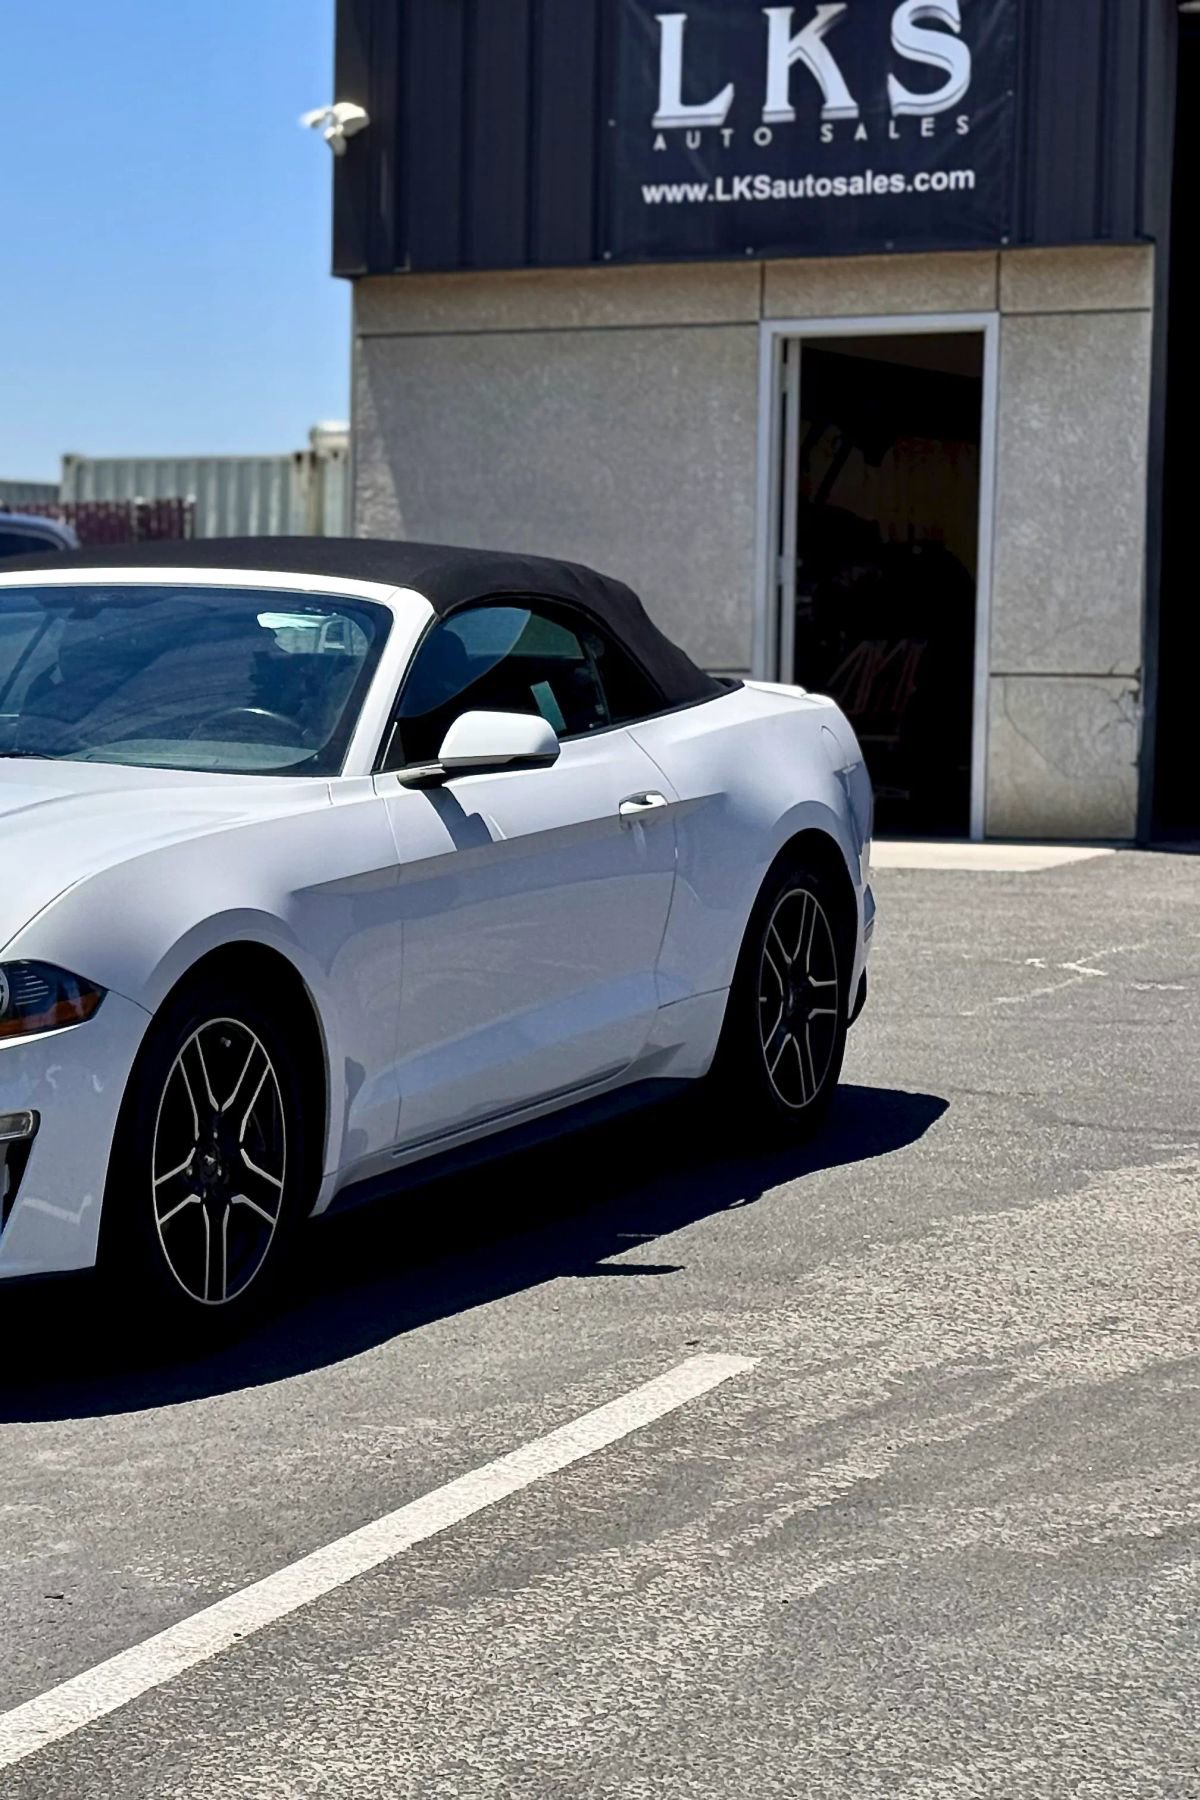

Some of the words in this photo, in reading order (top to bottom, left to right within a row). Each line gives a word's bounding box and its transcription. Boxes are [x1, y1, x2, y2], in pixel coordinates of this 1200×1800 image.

[652, 0, 971, 128] LKS
[653, 127, 773, 151] AUTO
[820, 115, 970, 143] SALES
[641, 168, 975, 204] www.LKSautosales.com
